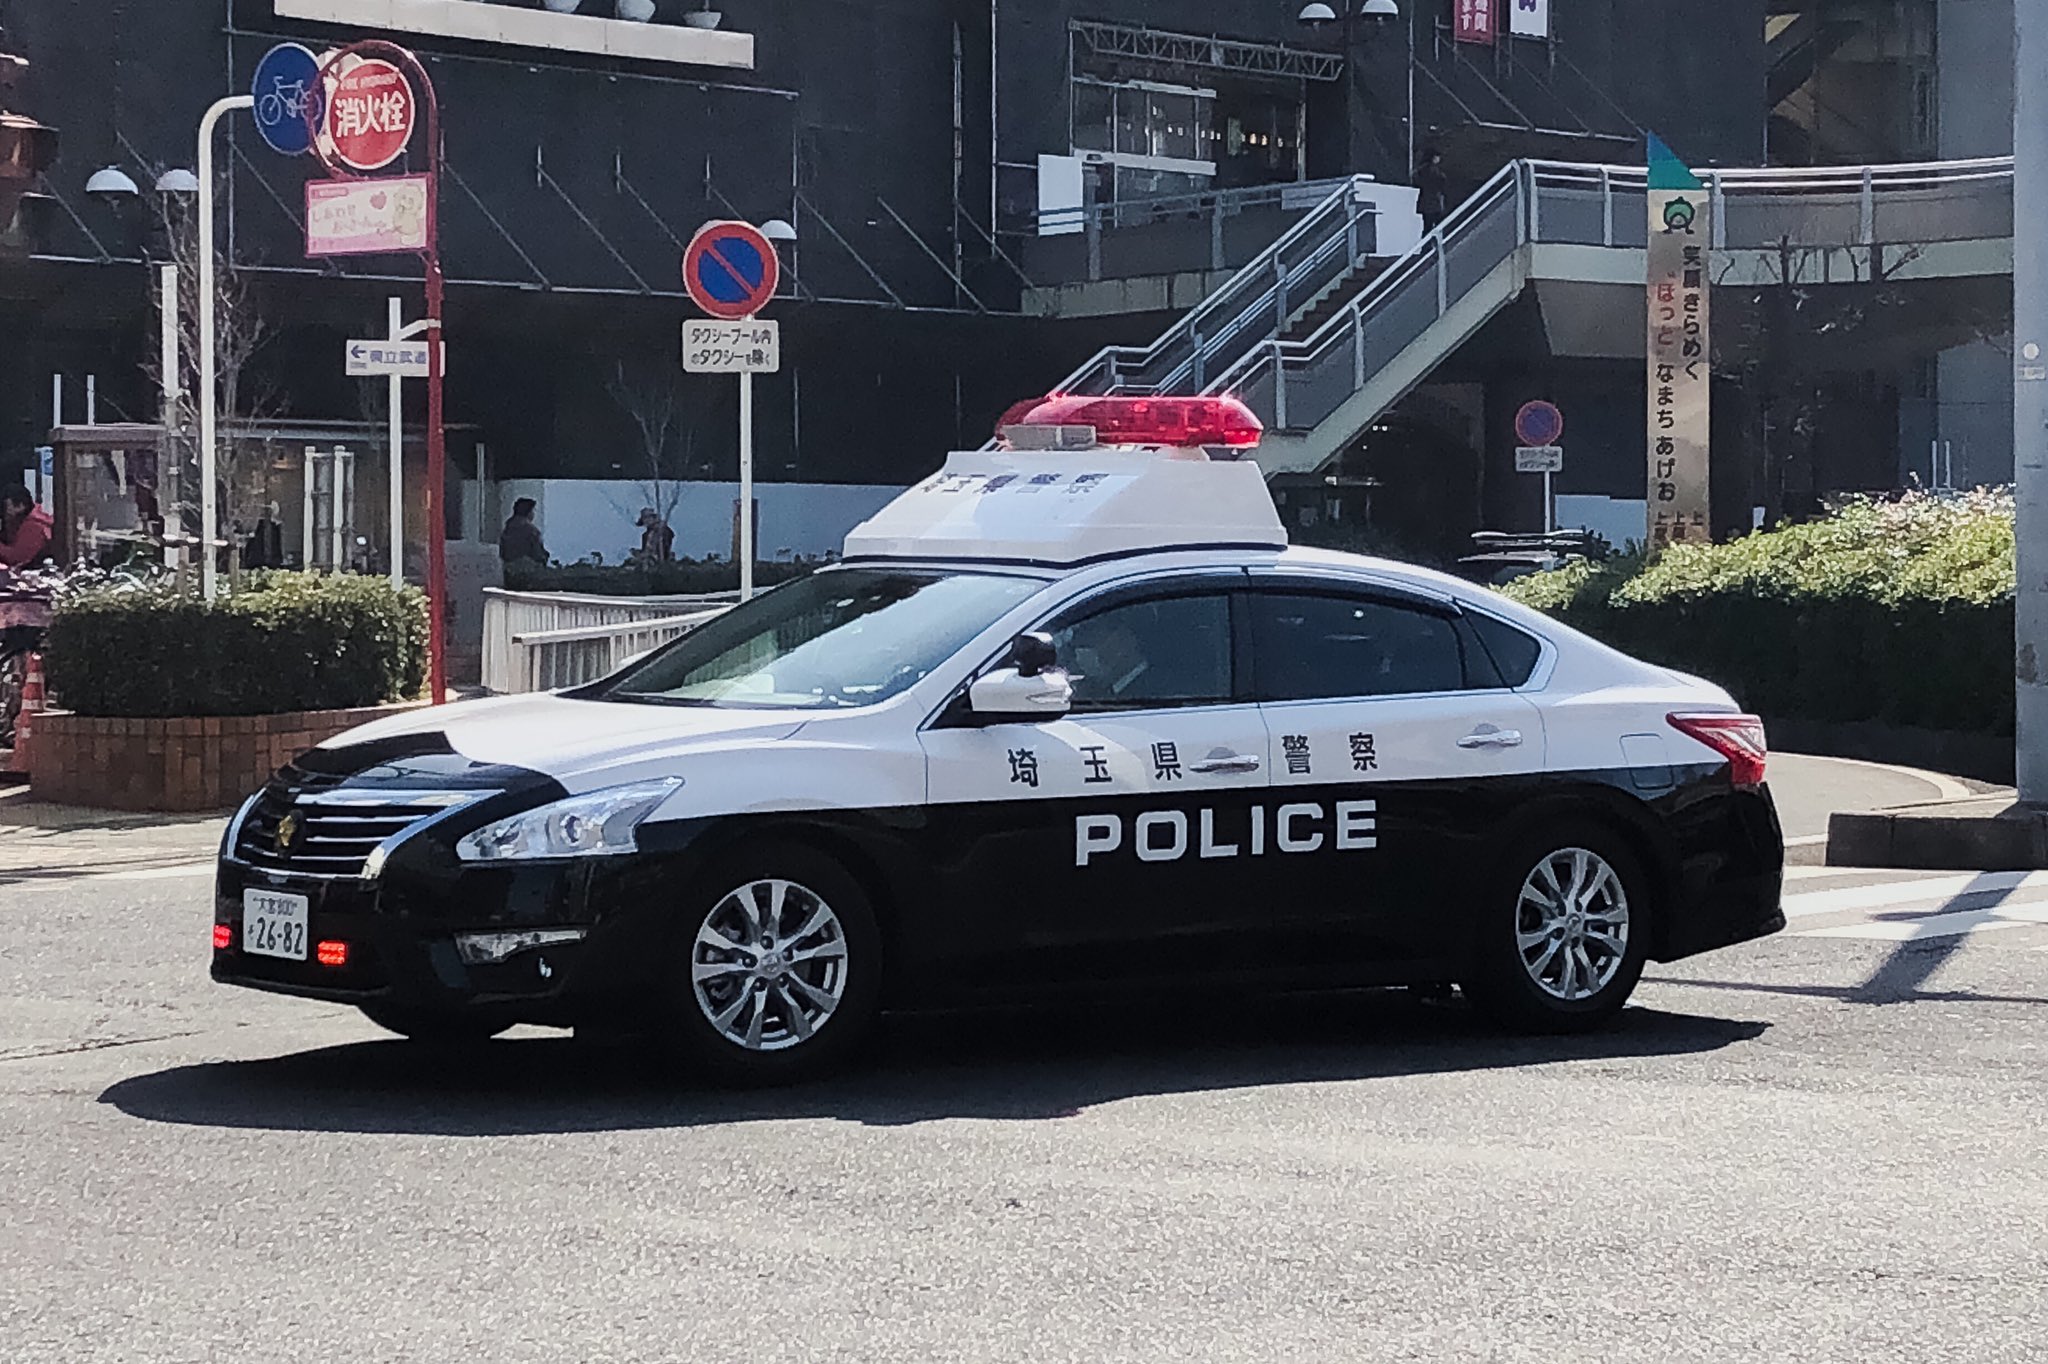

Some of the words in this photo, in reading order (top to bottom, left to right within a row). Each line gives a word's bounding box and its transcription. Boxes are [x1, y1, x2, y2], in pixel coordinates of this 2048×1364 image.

[335, 91, 406, 137] 消火栓
[1007, 732, 1379, 788] 埼玉県警察
[1075, 799, 1378, 867] POLICE
